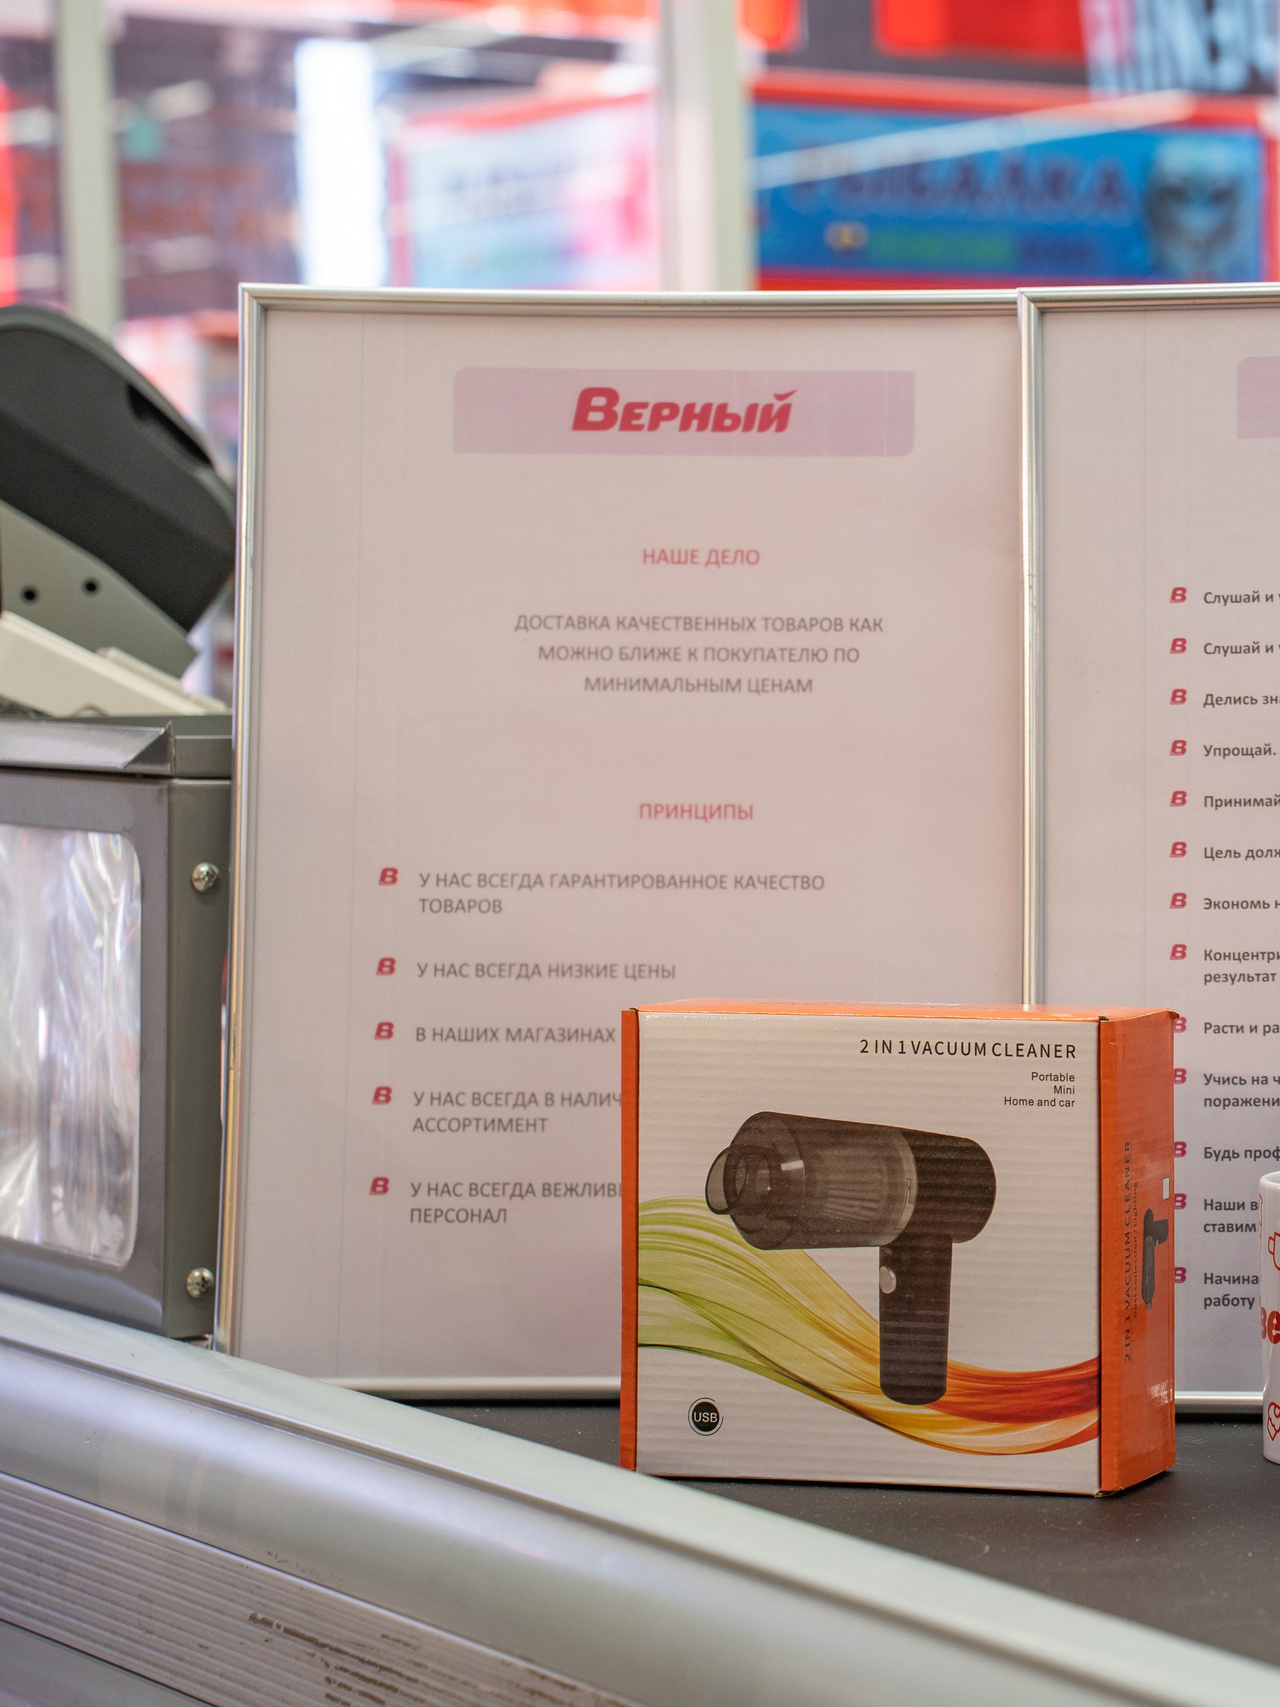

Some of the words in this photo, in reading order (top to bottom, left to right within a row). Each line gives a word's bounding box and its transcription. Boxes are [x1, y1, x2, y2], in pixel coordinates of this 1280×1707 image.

[642, 548, 700, 566] НАШЕ
[703, 548, 761, 569] ДЕЛО
[1203, 589, 1261, 607] Слушай
[1264, 593, 1274, 603] и
[513, 614, 612, 634] ДОСТАВКА
[615, 615, 757, 633] КАЧЕСТВЕННЫХ
[761, 616, 845, 633] ТОВАРОВ
[849, 616, 884, 633] КАК
[538, 645, 614, 662] МОЖНО
[618, 645, 682, 663] БЛИЖЕ
[687, 646, 699, 662] К
[703, 646, 830, 664] ПОКУПАТЕЛЮ
[833, 647, 861, 664] ПО
[1203, 640, 1261, 658] Слушай
[1264, 644, 1274, 654] и
[584, 676, 742, 693] МИНИМАЛЬНЫМ
[747, 677, 814, 697] ЦЕНАМ
[1202, 693, 1259, 709] Делись
[1202, 742, 1277, 760] Упрощай.
[639, 802, 754, 824] ПРИНЦИПЫ
[1203, 846, 1242, 862] Цель
[418, 872, 432, 889] У
[435, 872, 473, 889] НАС
[477, 872, 545, 892] ВСЕГДА
[549, 873, 729, 891] ГАРАНТИРОВАННОЕ
[733, 874, 826, 891] КАЧЕСТВО
[418, 897, 503, 915] ТОВАРОВ
[1203, 897, 1271, 911] Экономь
[416, 962, 429, 979] У
[433, 962, 470, 979] НАС
[474, 962, 543, 982] ВСЕГДА
[547, 962, 619, 980] НИЗКИЕ
[623, 963, 676, 982] ЦЕНЫ
[1203, 972, 1278, 986] результат
[415, 1026, 427, 1043] В
[431, 1026, 500, 1043] НАШИХ
[505, 1027, 616, 1044] МАГАЗИНАХ
[1203, 1021, 1245, 1035] Расти
[1249, 1024, 1258, 1034] и
[860, 1039, 869, 1054] 2
[874, 1040, 893, 1054] IN
[898, 1040, 906, 1054] 1
[911, 1040, 987, 1057] VACUUM
[992, 1042, 1076, 1059] CLEANER
[1031, 1072, 1075, 1083] Portable
[1202, 1073, 1248, 1086] Учись
[1250, 1075, 1269, 1086] на
[1053, 1085, 1075, 1095] Mini
[413, 1091, 426, 1107] У
[429, 1091, 467, 1108] НАС
[471, 1091, 540, 1111] ВСЕГДА
[544, 1091, 556, 1108] В
[1004, 1096, 1034, 1107] Home
[1037, 1098, 1056, 1107] and
[411, 1116, 549, 1134] АССОРТИМЕНТ
[1203, 1146, 1241, 1163] Будь
[410, 1181, 423, 1198] У
[426, 1181, 464, 1198] НАС
[468, 1181, 537, 1201] ВСЕГДА
[541, 1181, 621, 1198] ВЕЖЛИВ
[1203, 1198, 1246, 1212] Наши
[409, 1207, 508, 1224] ПЕРСОНАЛ
[1203, 1222, 1257, 1233] ставим
[1203, 1293, 1256, 1310] работу
[1125, 1329, 1131, 1347] IN
[693, 1411, 718, 1423] USB
